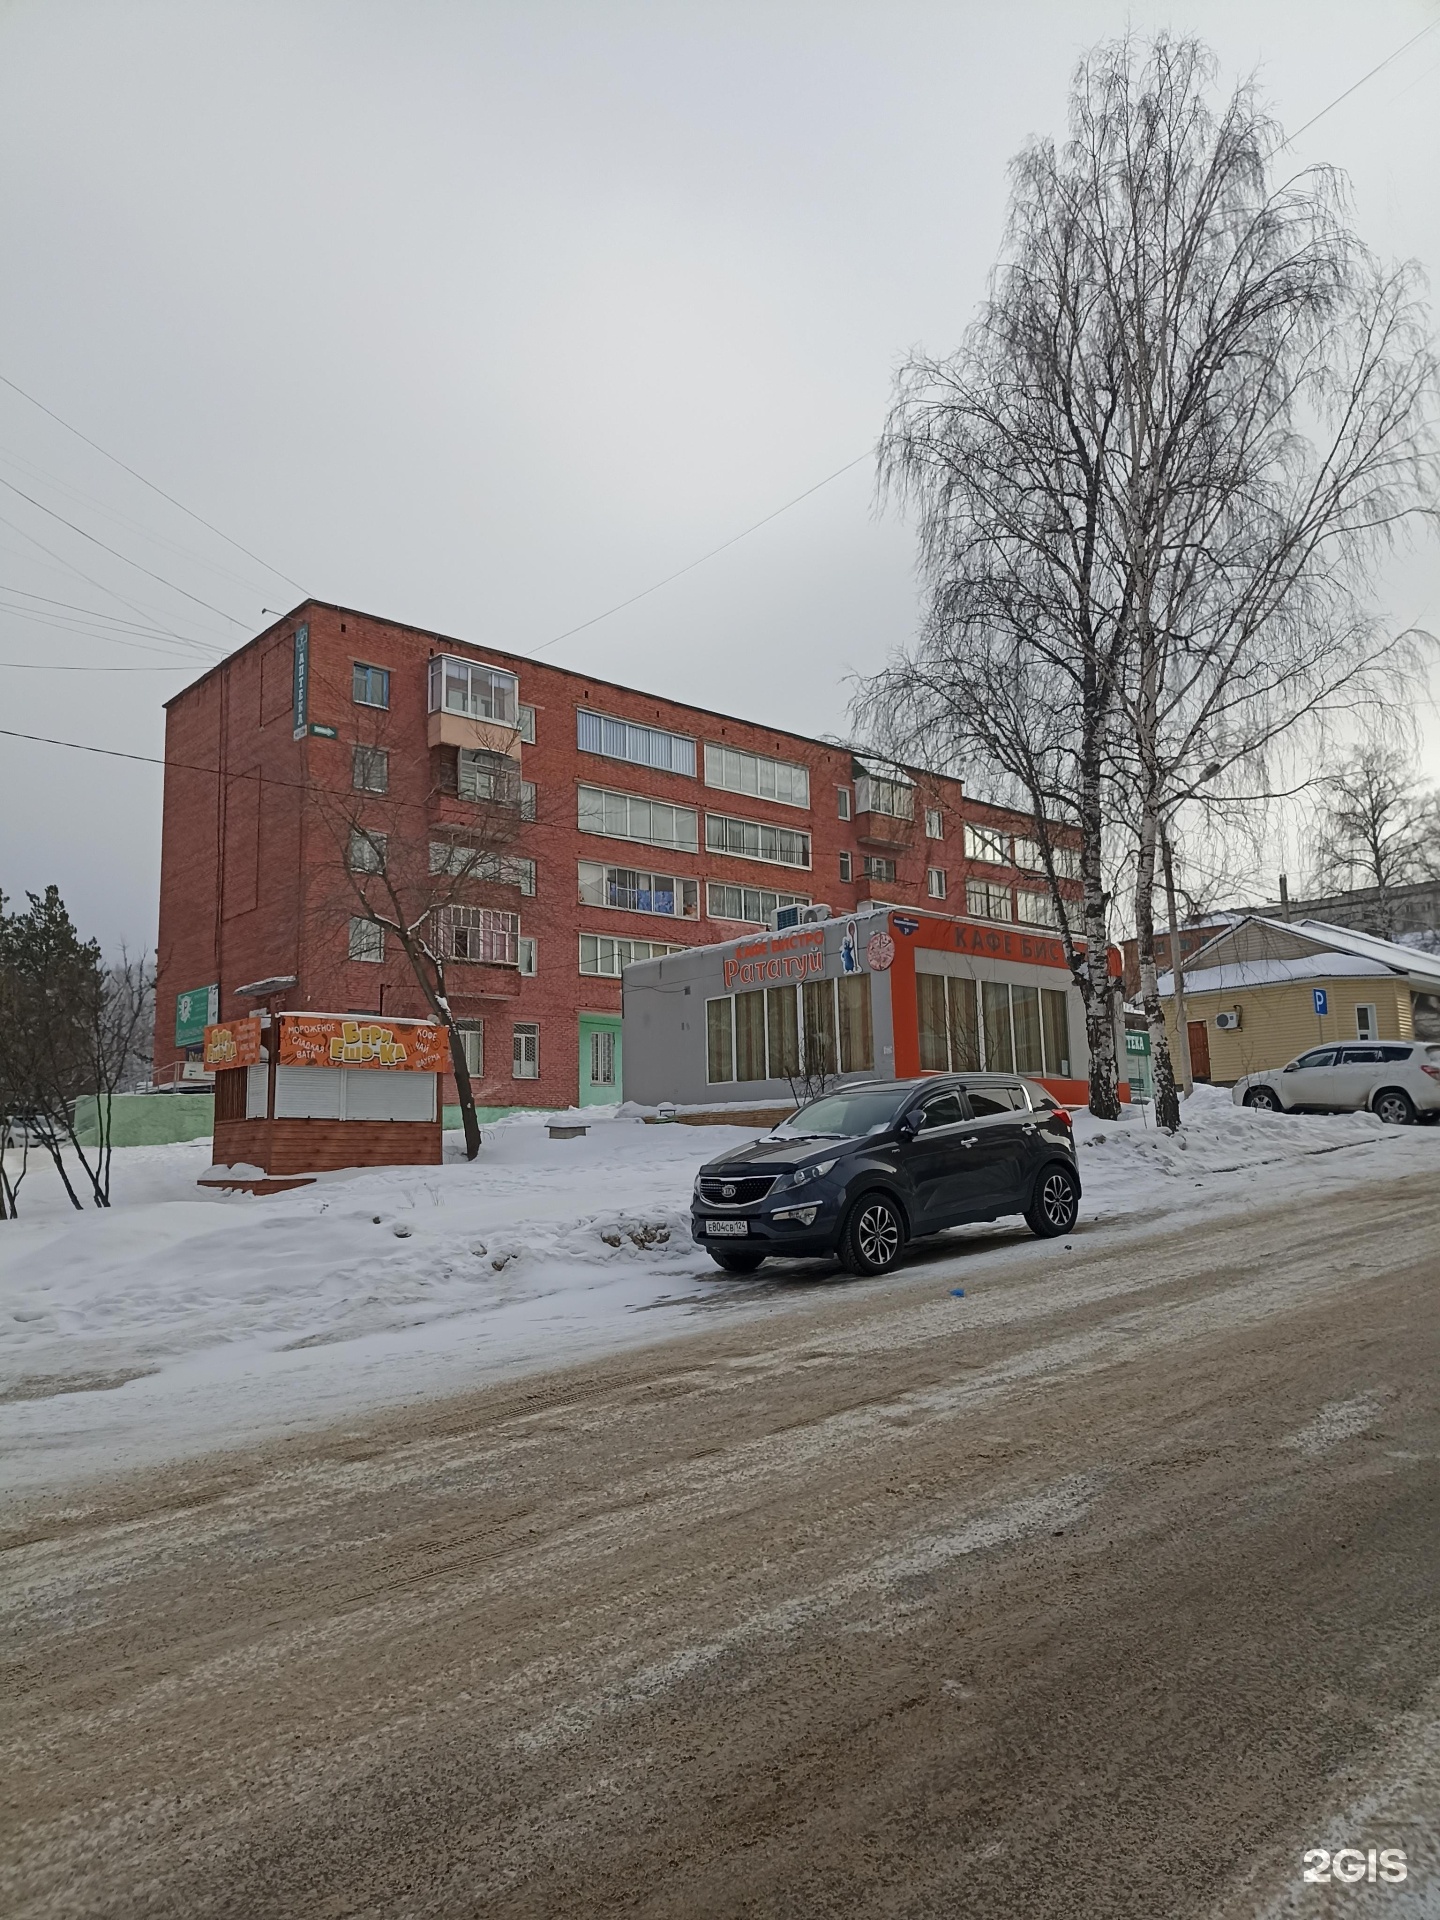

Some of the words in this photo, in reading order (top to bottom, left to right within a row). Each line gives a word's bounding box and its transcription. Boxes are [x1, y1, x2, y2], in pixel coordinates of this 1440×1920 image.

[736, 942, 768, 960] КАФЕ
[771, 930, 824, 954] БИСТРО
[954, 926, 1011, 954] КАФЕ
[1021, 938, 1060, 961] БИС
[724, 948, 823, 988] Рататуй
[288, 1023, 336, 1034] МОРОЖЕНОЕ
[416, 1028, 438, 1042] КОФЕ
[292, 1037, 325, 1054] СЛАДКАЯ
[415, 1041, 430, 1053] ЧАЙ
[1125, 1035, 1144, 1050] ТЕКА
[296, 1050, 316, 1059] ВАТА
[723, 1187, 733, 1195] KIA
[735, 1221, 745, 1229] 124
